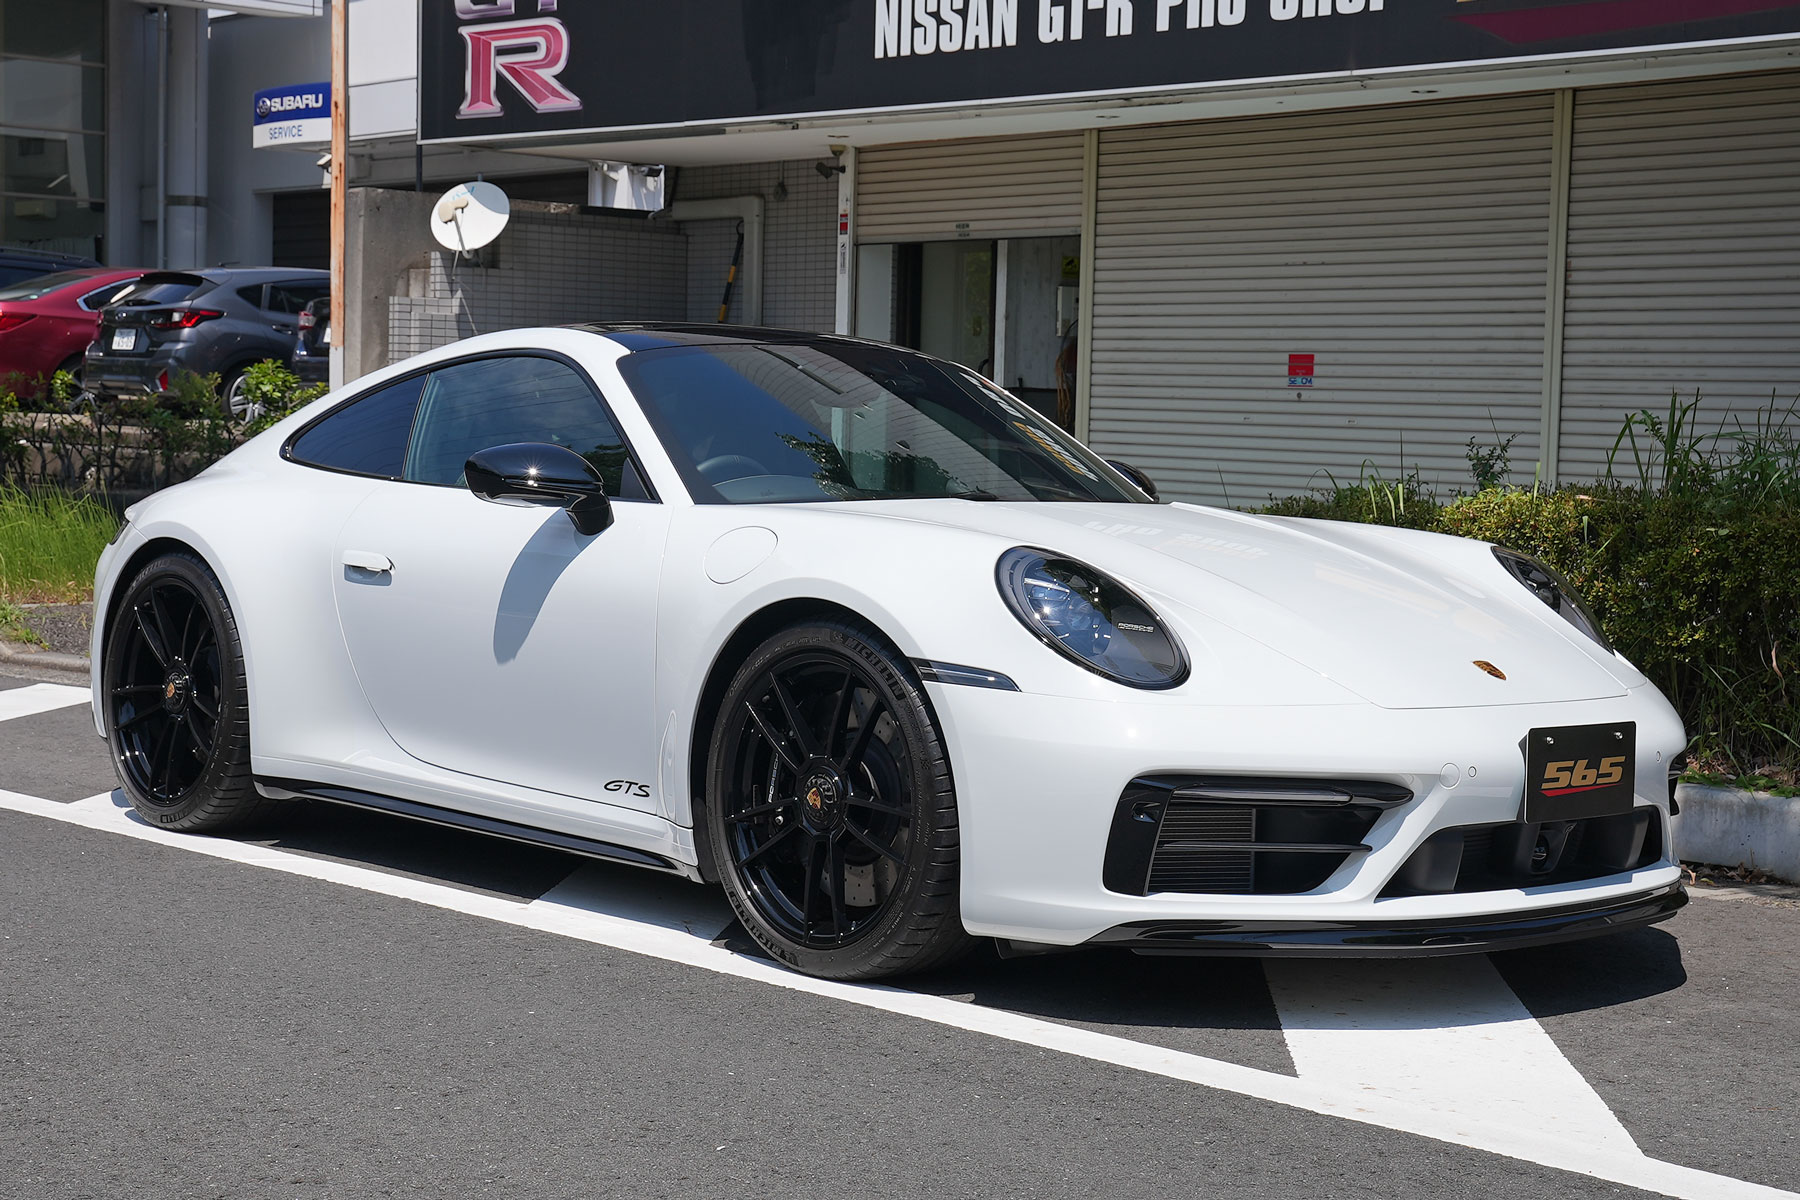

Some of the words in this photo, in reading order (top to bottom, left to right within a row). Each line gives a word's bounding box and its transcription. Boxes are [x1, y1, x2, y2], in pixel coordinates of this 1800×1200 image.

[874, 0, 1017, 59] NISSAN
[270, 93, 323, 112] SUBARU
[268, 125, 303, 140] SERVICE
[844, 637, 906, 700] MICHELIN
[1541, 756, 1626, 789] 565
[603, 779, 650, 798] GTS
